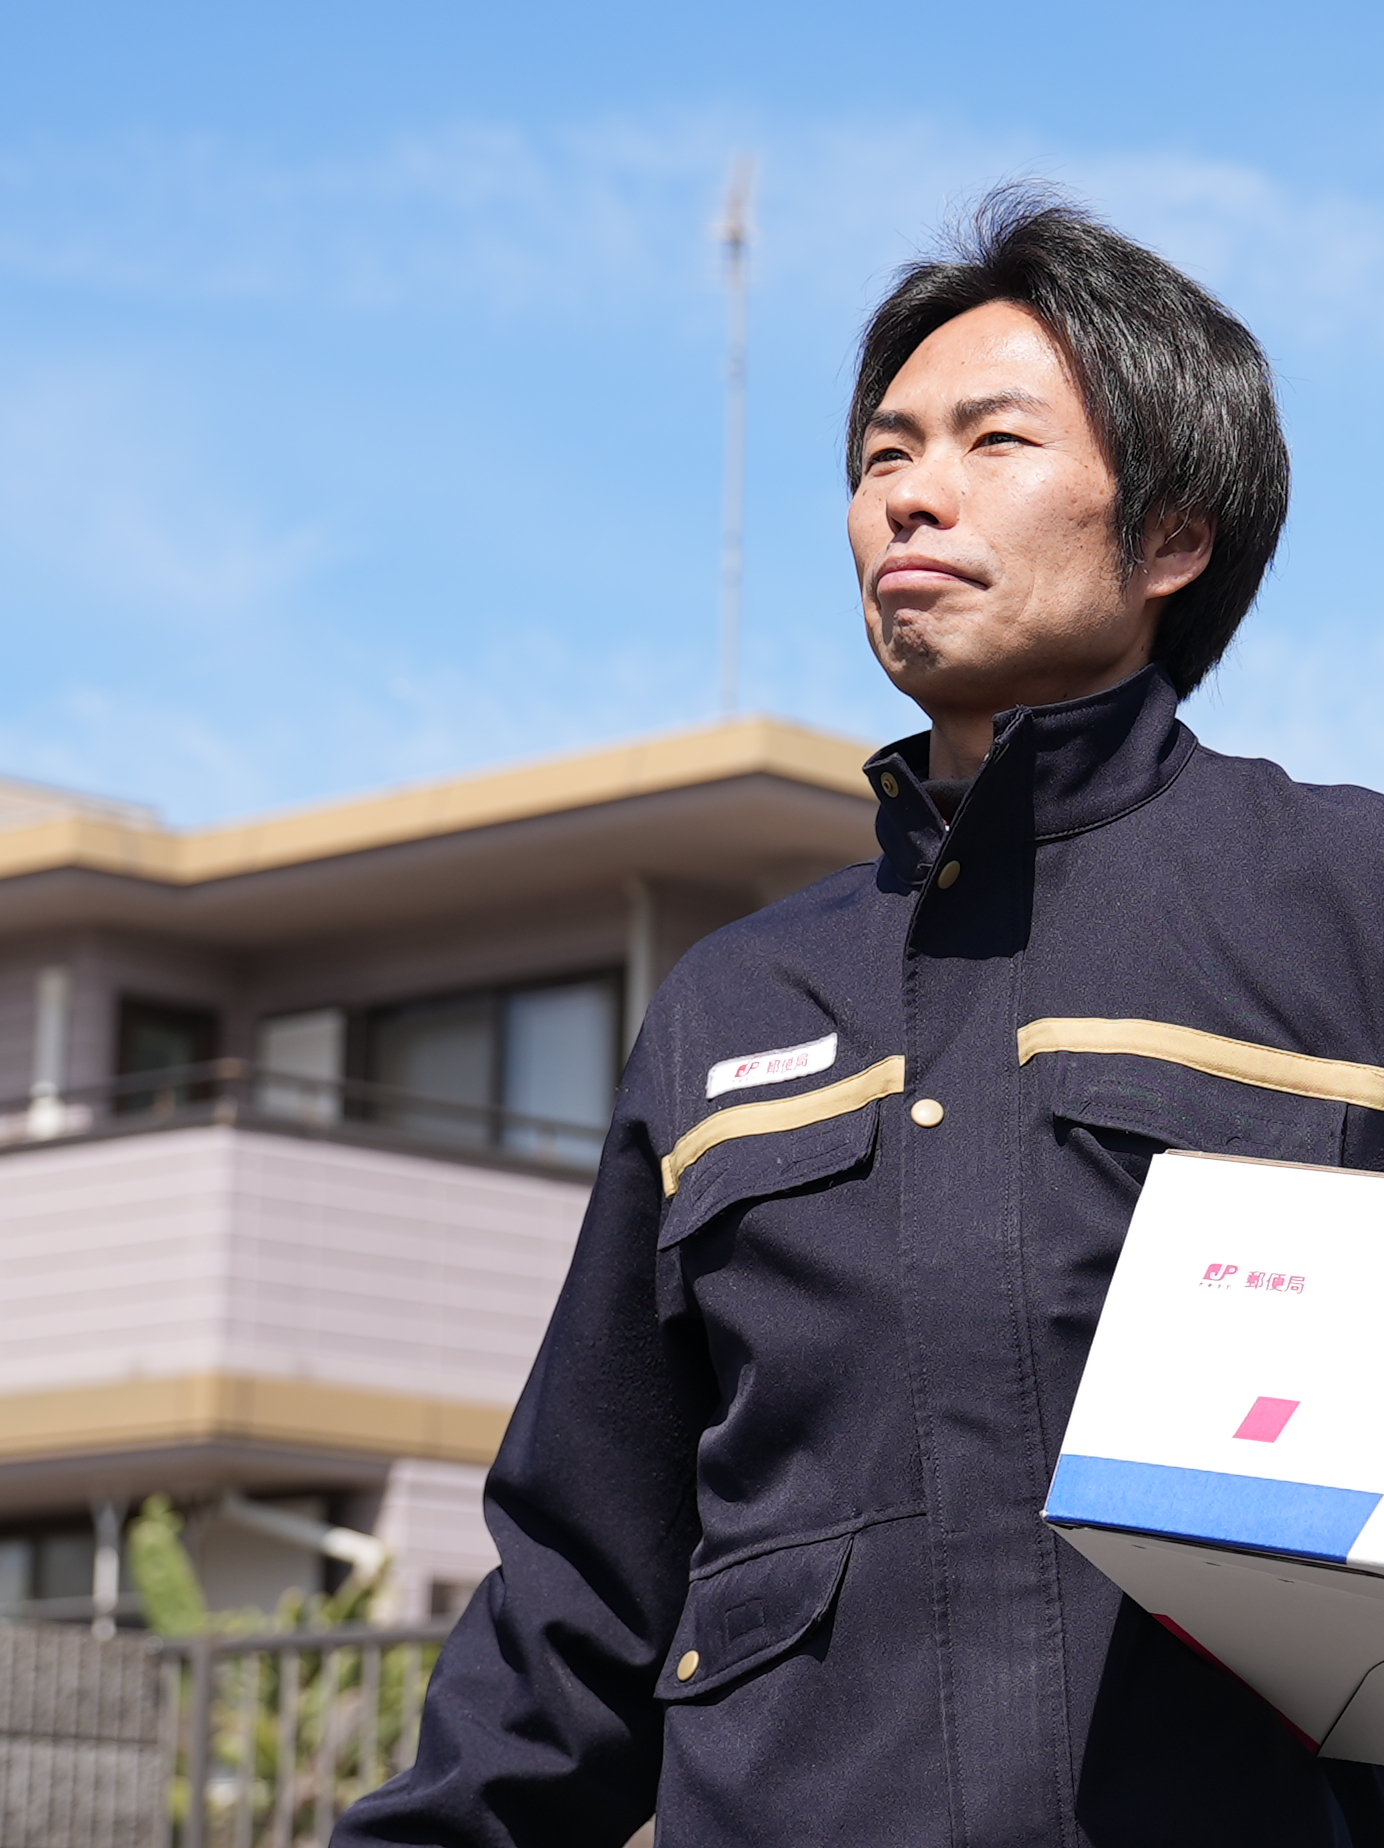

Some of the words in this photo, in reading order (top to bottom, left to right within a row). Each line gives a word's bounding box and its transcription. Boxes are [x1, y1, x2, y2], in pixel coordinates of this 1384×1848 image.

[1202, 1263, 1239, 1281] JP
[1244, 1270, 1306, 1295] 郵便局
